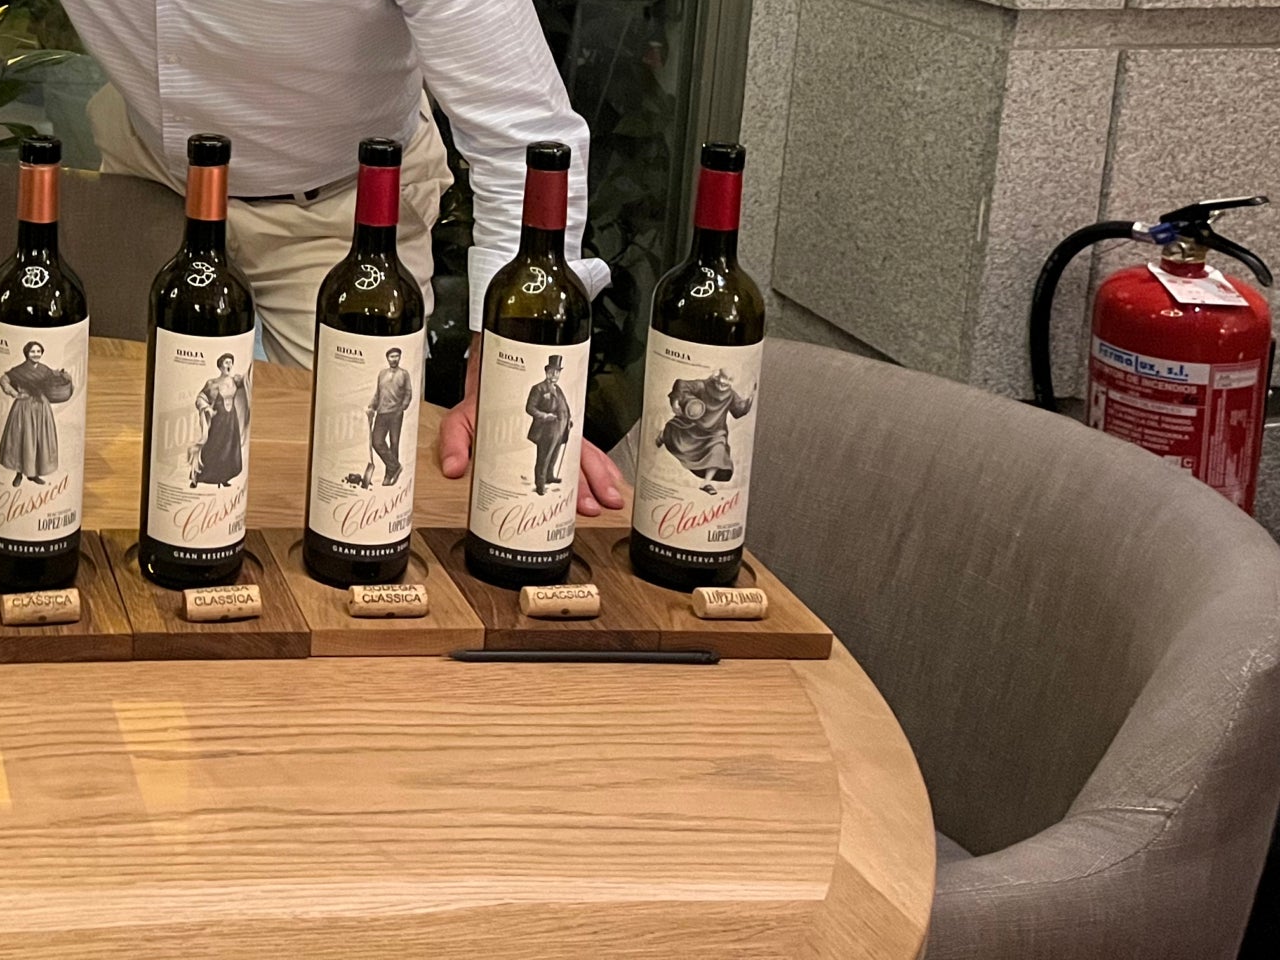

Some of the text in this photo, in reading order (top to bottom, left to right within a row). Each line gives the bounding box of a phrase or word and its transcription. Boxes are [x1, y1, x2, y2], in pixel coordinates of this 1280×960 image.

[176, 348, 205, 359] RIOJA
[336, 345, 363, 357] RIOJA
[498, 351, 525, 364] RIOJA
[665, 348, 691, 361] RIOJA
[651, 491, 740, 539] Classica
[38, 515, 62, 531] LOPEZ
[8, 544, 46, 553] RESERVA
[173, 550, 198, 560] GRAN
[202, 549, 234, 560] RESERVA
[332, 544, 357, 556] GRAN
[360, 548, 394, 557] RESERVA
[489, 547, 513, 560] GRAN
[517, 554, 553, 563] RESERVA
[649, 544, 672, 558] GRAN
[676, 553, 715, 563] RESERVA
[11, 593, 73, 608] CLASSICA
[194, 594, 255, 607] CLASSICA
[362, 593, 422, 604] CLASSICA
